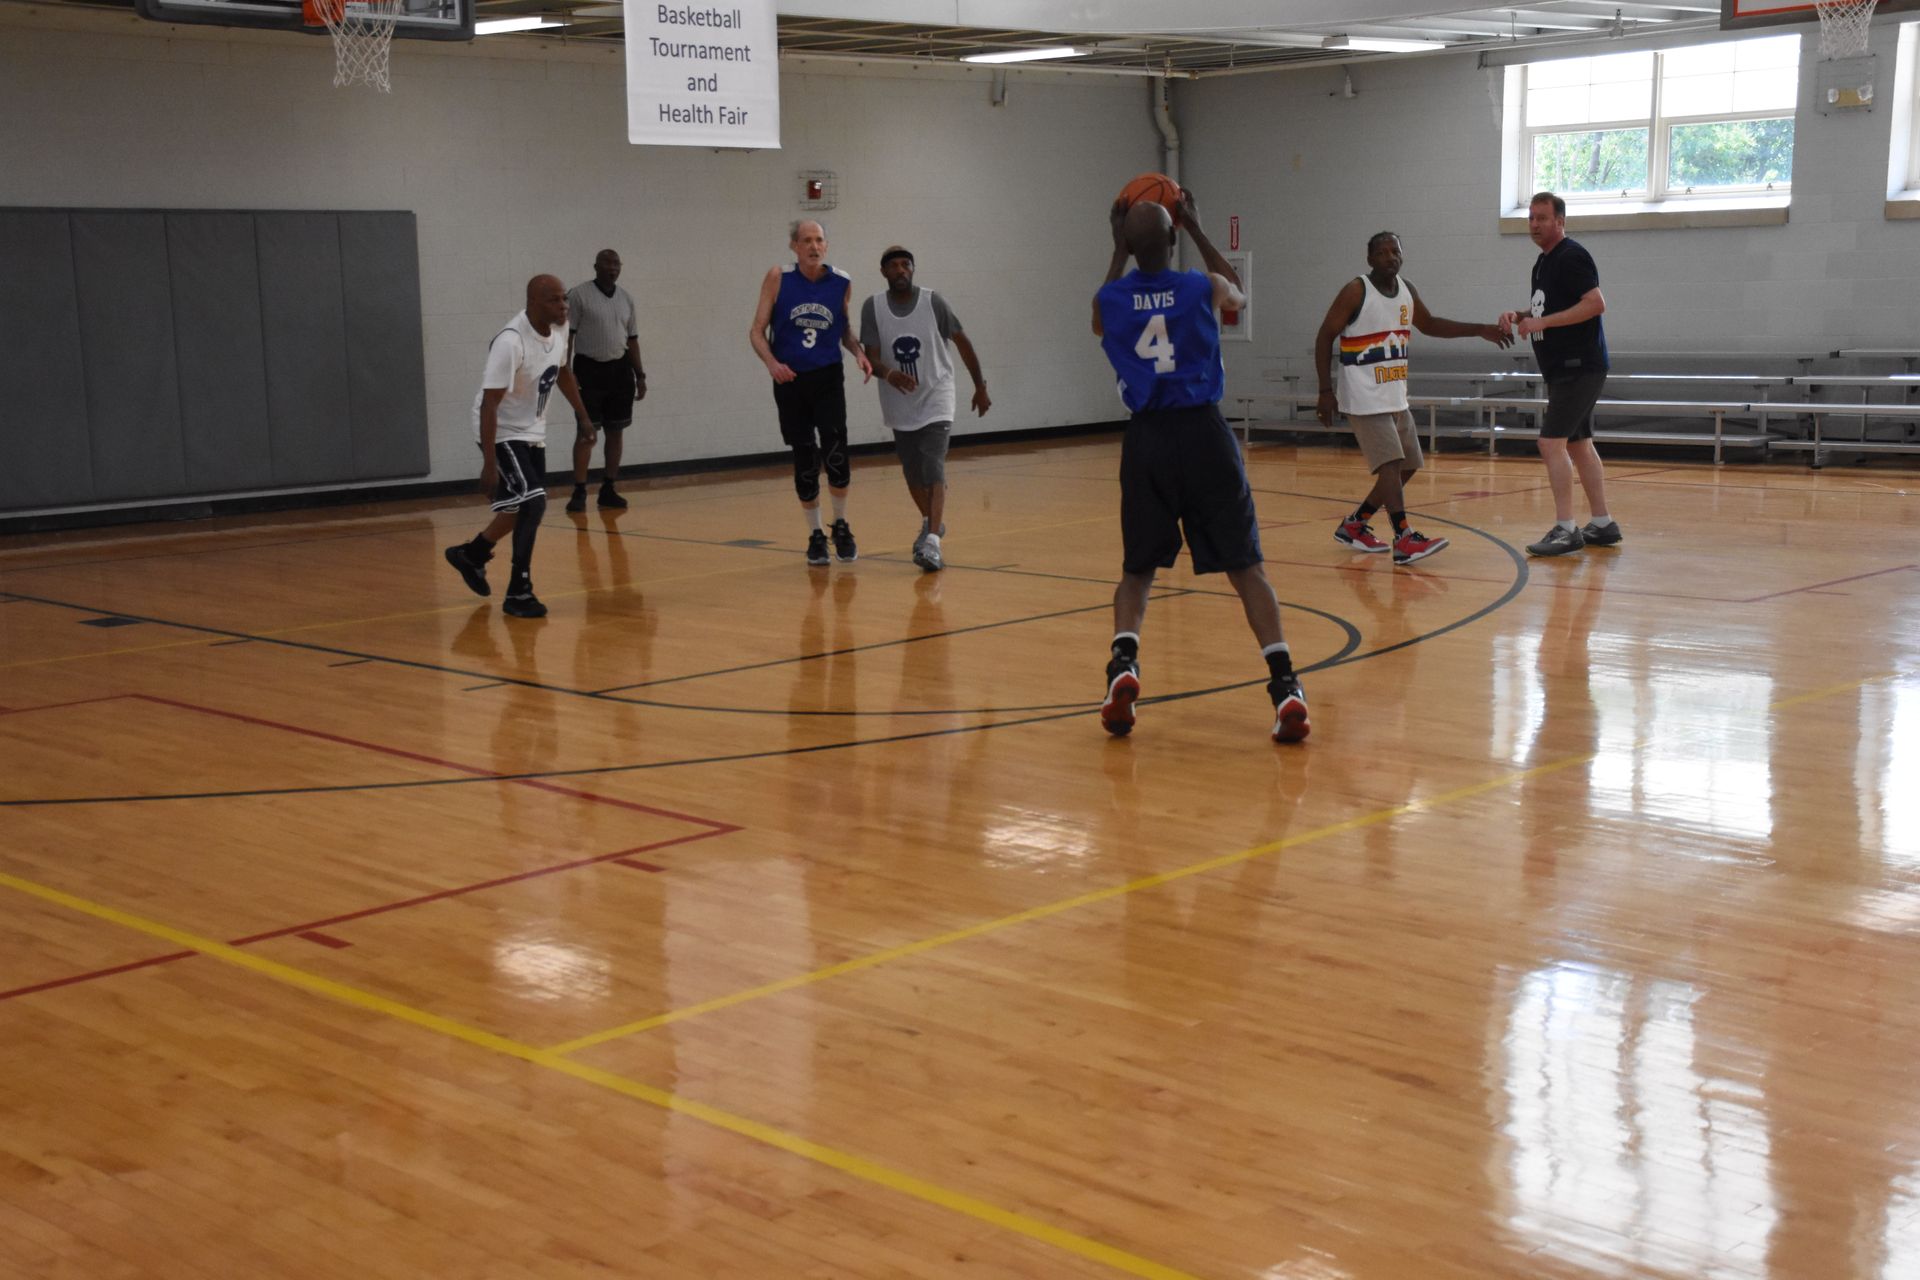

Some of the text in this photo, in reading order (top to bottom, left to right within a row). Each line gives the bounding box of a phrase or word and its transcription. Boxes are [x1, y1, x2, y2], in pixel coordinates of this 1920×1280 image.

[657, 4, 741, 29] Basketball
[649, 37, 751, 62] Tournament
[687, 73, 718, 92] and
[659, 103, 748, 126] Health Fair
[1133, 291, 1175, 310] DAVIS
[802, 327, 817, 349] 3
[1134, 314, 1176, 374] 4
